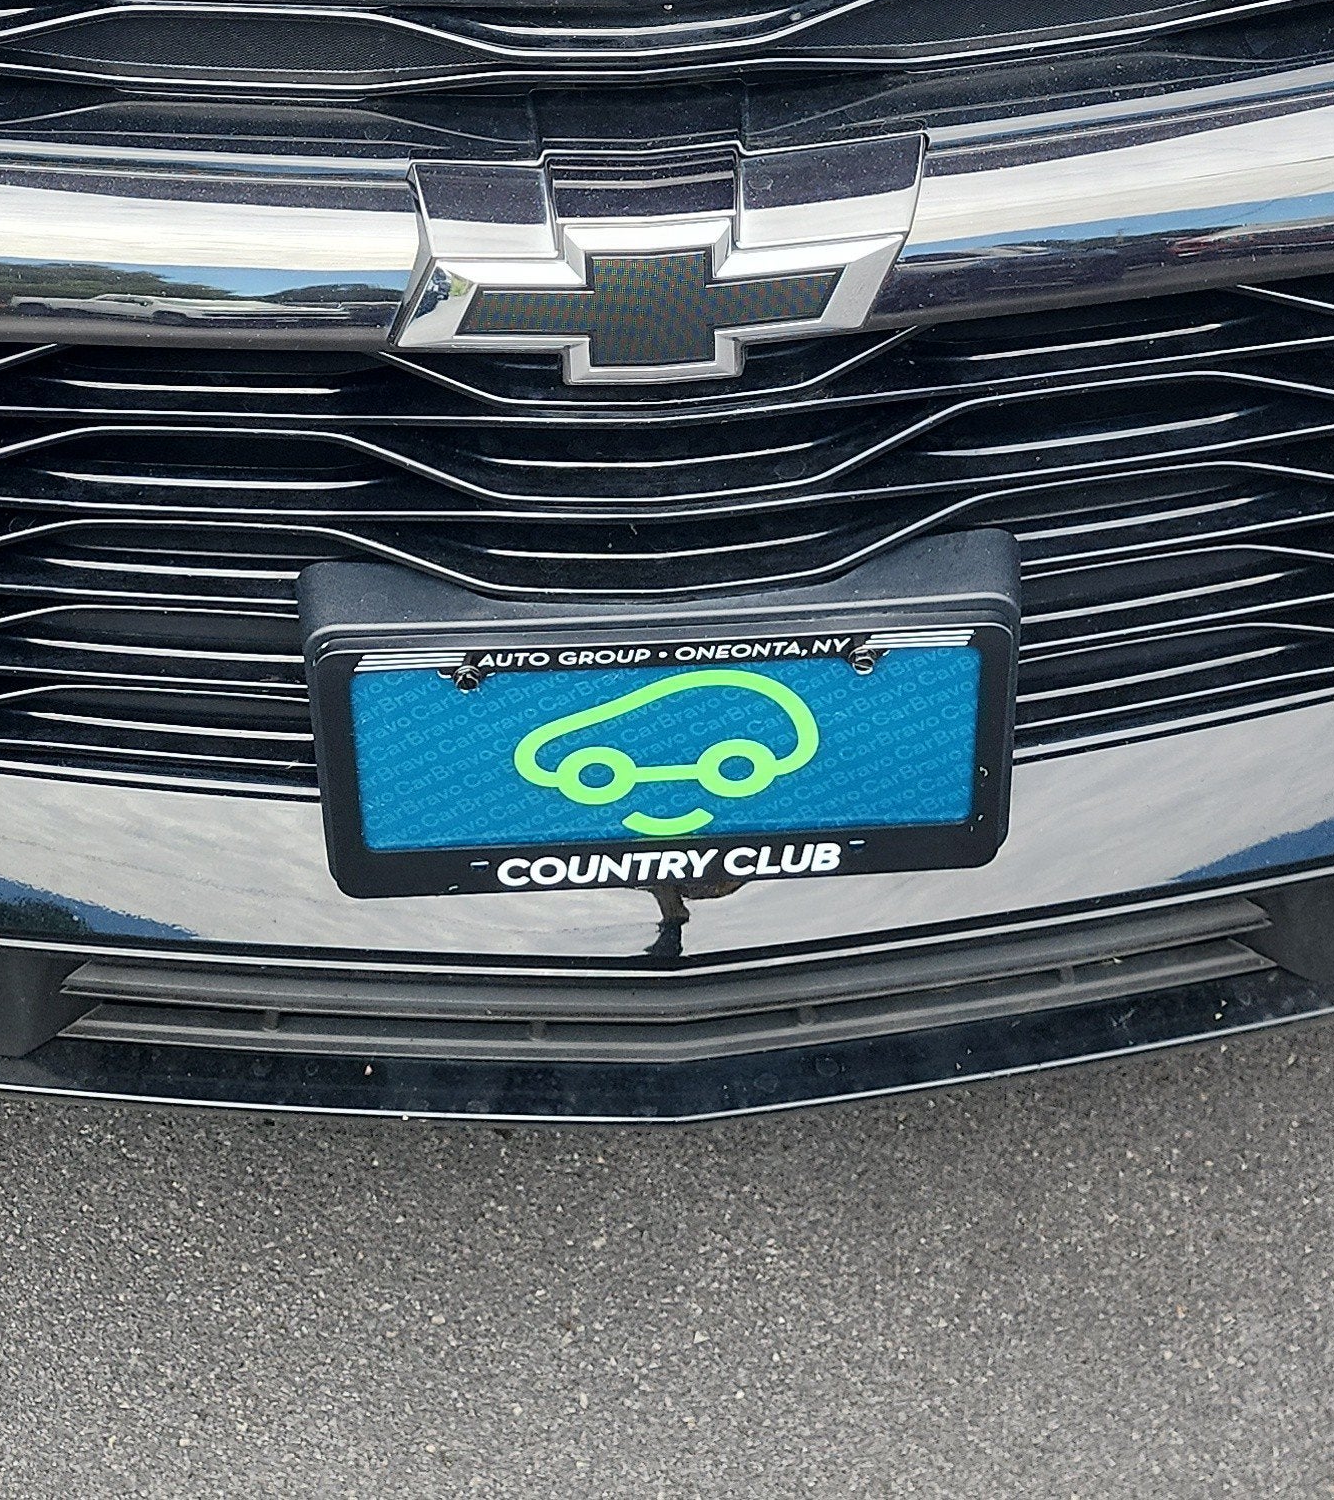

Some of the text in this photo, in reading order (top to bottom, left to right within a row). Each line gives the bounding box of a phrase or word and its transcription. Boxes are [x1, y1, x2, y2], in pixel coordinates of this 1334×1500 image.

[478, 652, 550, 668] AUTO
[558, 648, 651, 665] GROUP
[497, 842, 841, 886] COUNTRY CLUB
